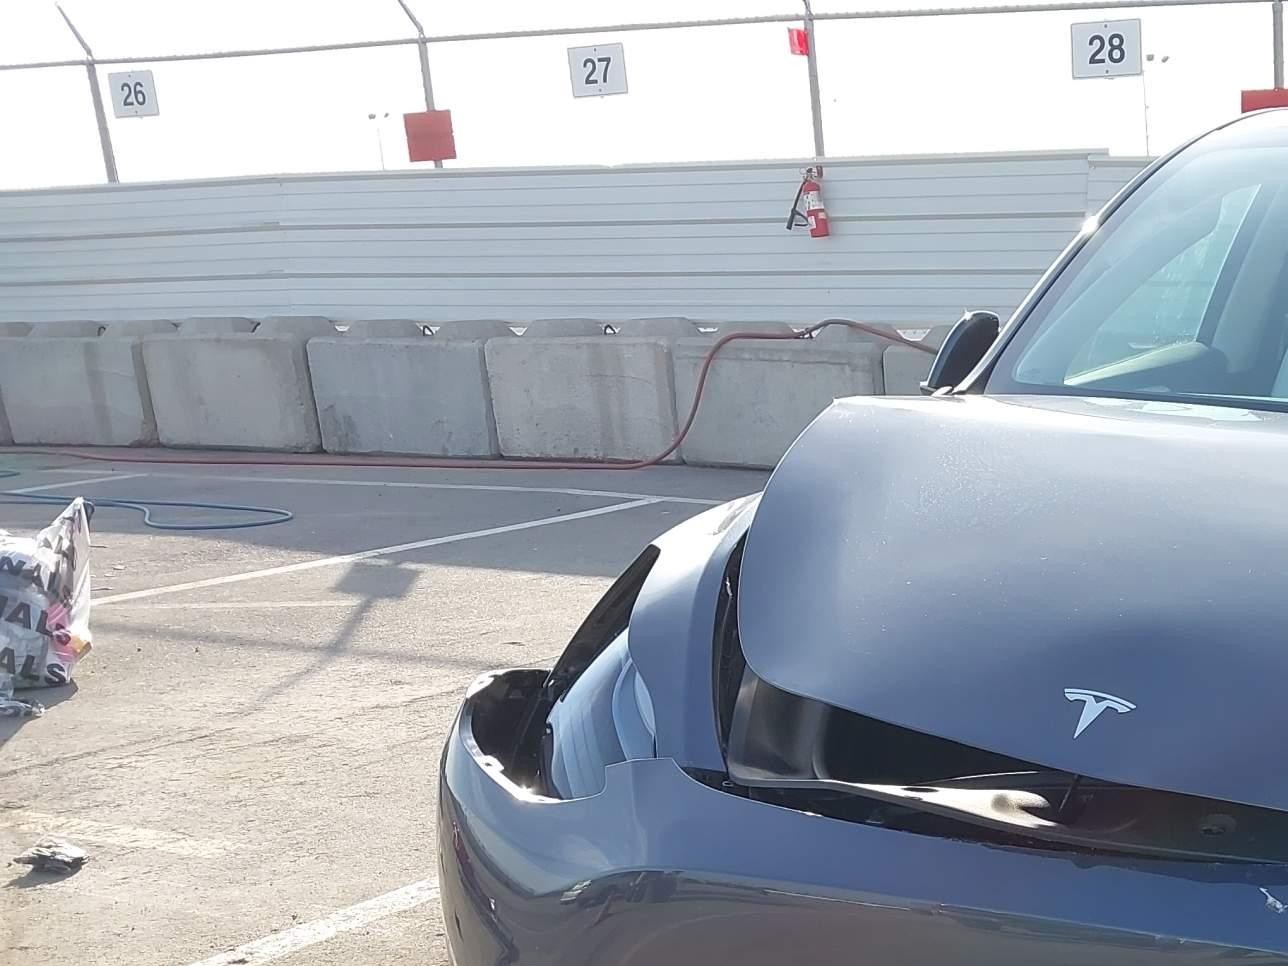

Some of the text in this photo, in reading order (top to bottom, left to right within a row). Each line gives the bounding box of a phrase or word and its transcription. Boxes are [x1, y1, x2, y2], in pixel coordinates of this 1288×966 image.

[1088, 33, 1125, 65] 28
[583, 57, 611, 84] 27
[121, 81, 146, 107] 26
